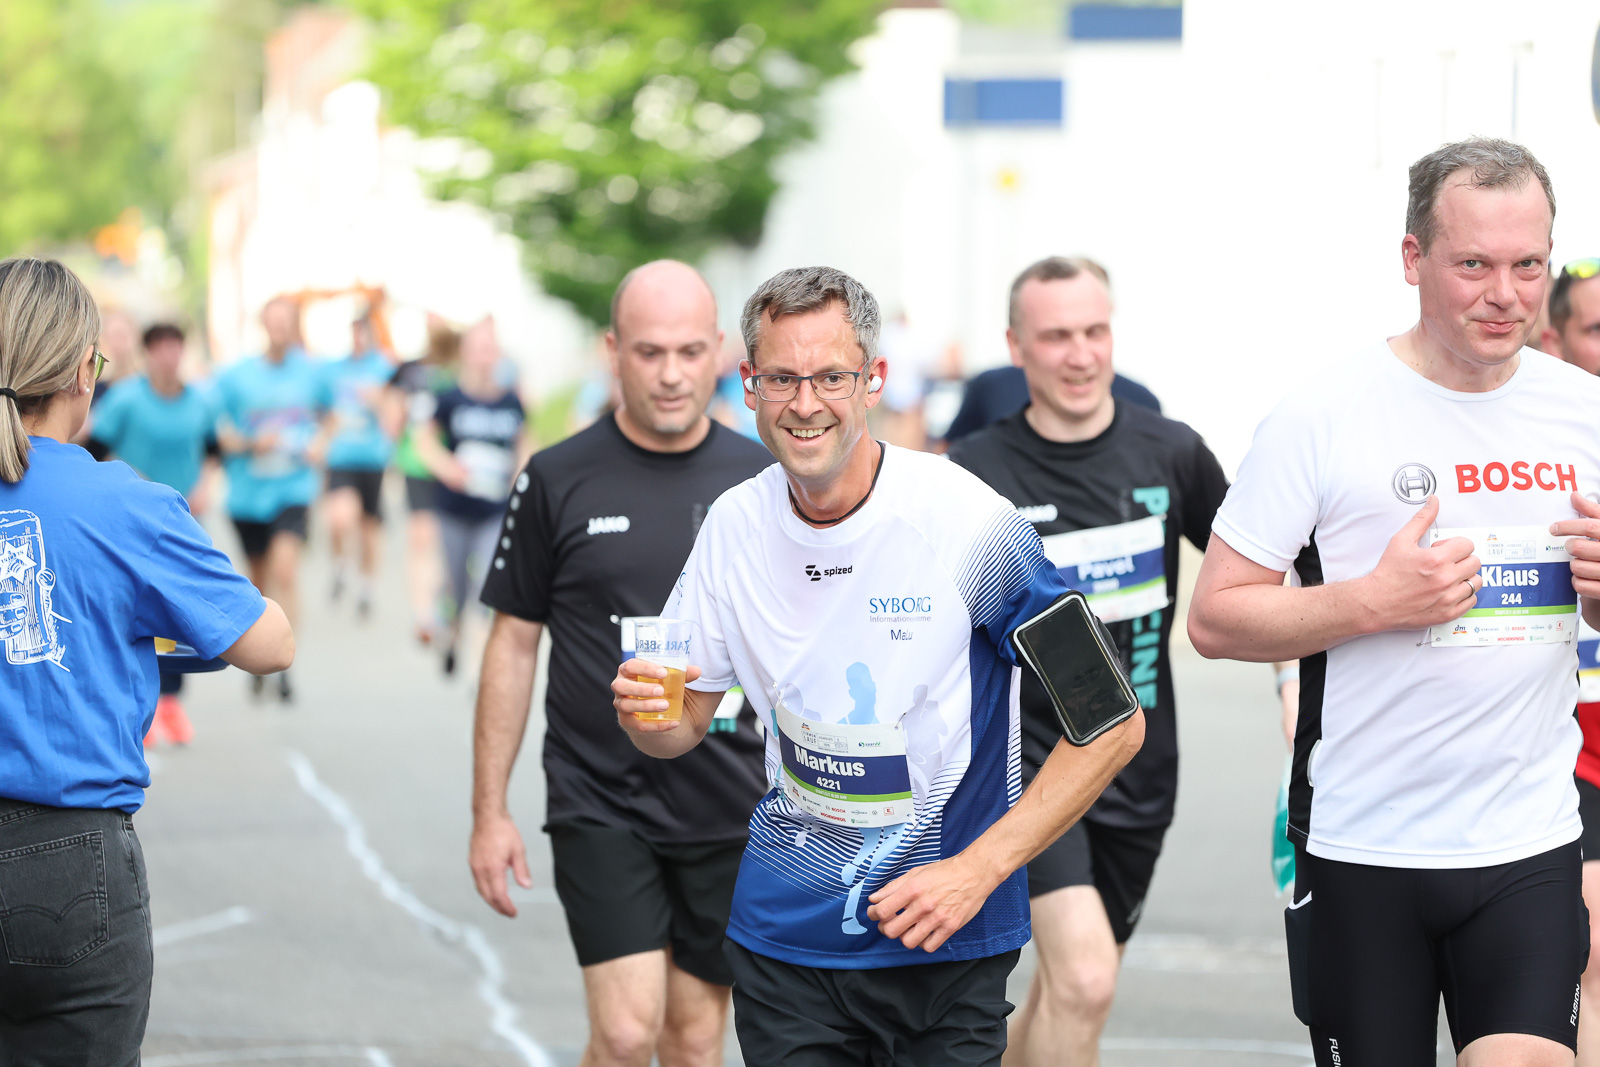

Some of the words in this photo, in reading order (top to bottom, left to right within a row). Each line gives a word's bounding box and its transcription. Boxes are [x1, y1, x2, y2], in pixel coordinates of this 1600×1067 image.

[1455, 461, 1578, 493] BOSCH
[587, 515, 631, 535] JAKO
[824, 565, 853, 577] spized
[1481, 565, 1540, 588] Klaus
[869, 596, 931, 614] SYBORG
[1501, 592, 1522, 605] 244
[793, 744, 866, 777] Markus
[816, 776, 841, 791] 4221
[1569, 983, 1581, 1027] FUSION
[1328, 1037, 1342, 1067] FUSI
